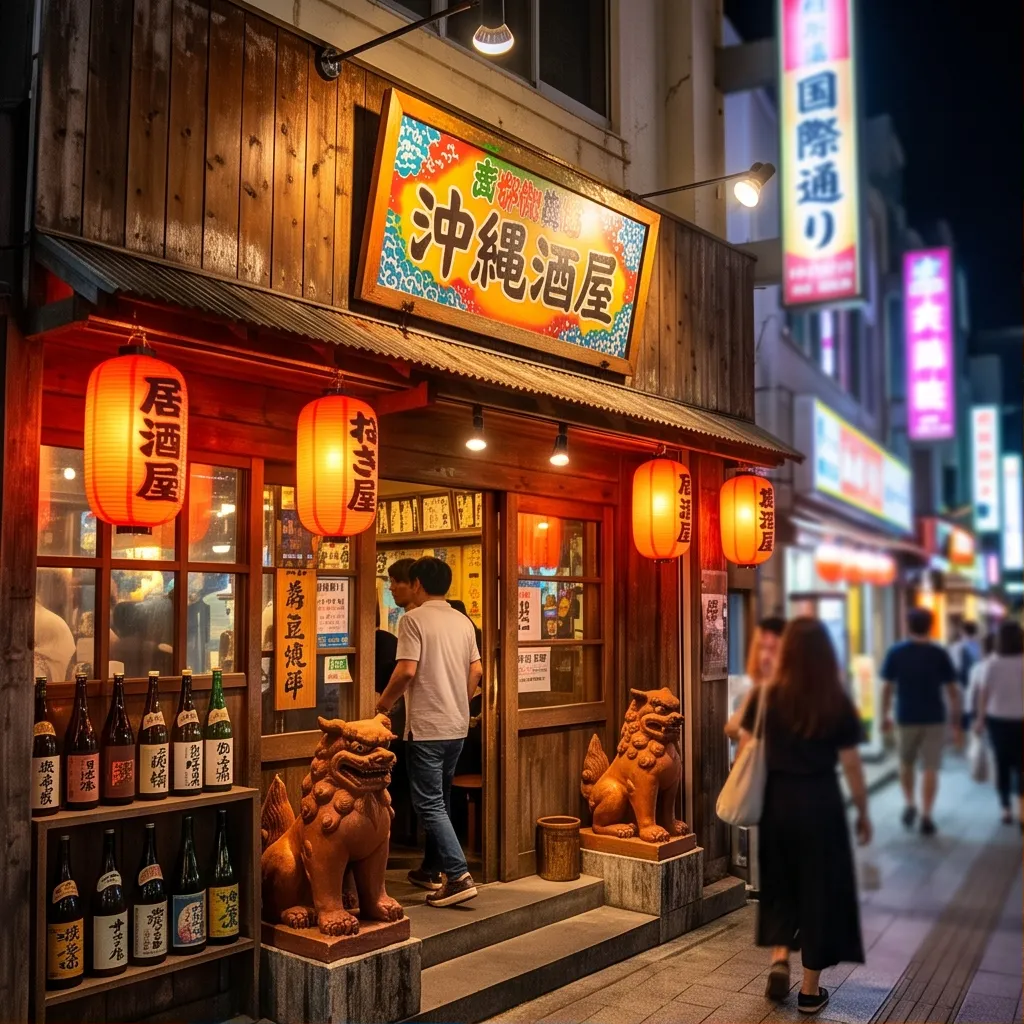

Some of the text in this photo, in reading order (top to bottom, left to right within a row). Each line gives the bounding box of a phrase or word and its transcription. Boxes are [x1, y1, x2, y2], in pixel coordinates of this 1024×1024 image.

[796, 70, 843, 250] 国際通り
[409, 186, 617, 324] 沖縄酒屋
[136, 376, 182, 502] 居酒屋
